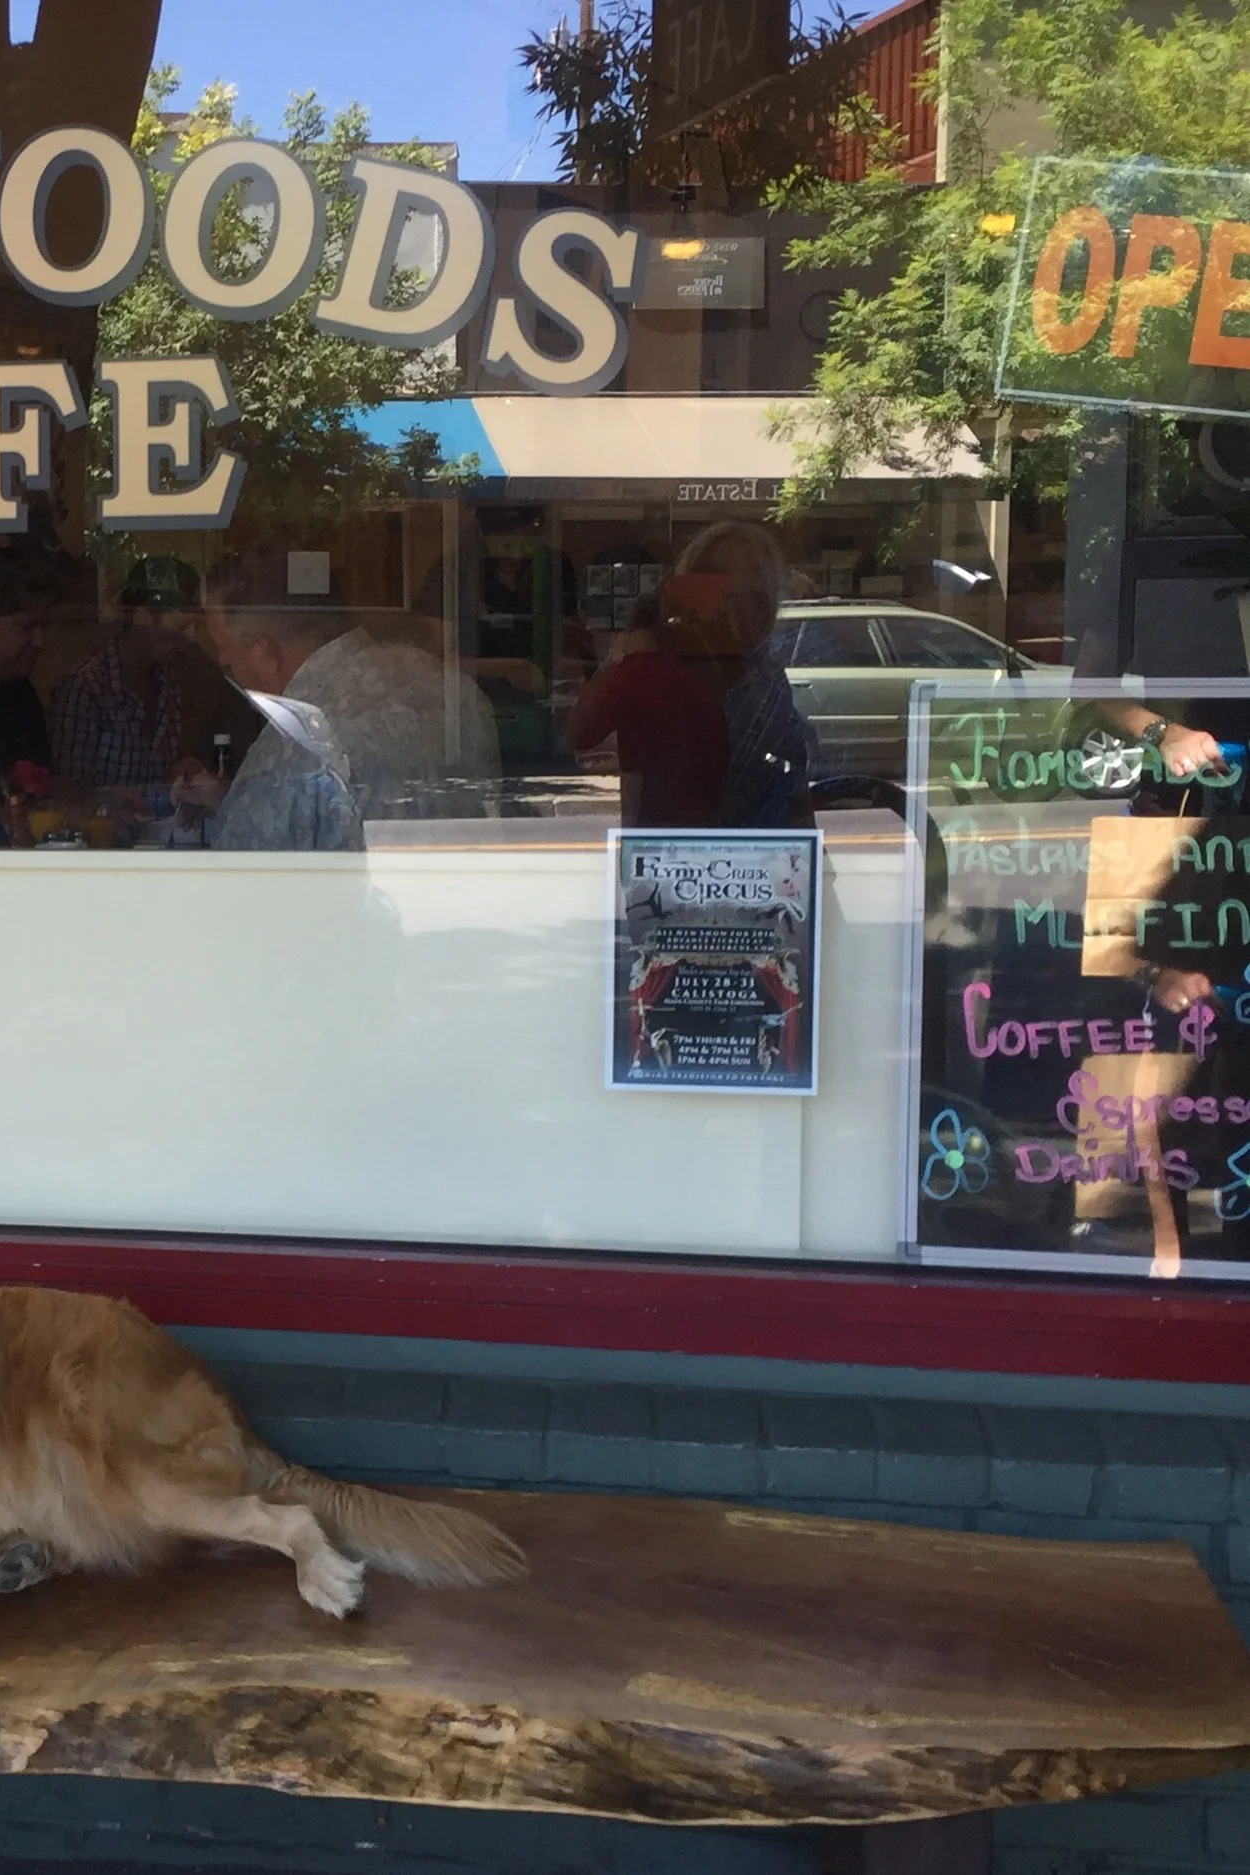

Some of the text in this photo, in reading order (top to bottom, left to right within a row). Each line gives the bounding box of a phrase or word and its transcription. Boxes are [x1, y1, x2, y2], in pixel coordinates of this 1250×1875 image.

[674, 878, 773, 904] CIRCUS
[674, 976, 709, 987] JULY
[671, 988, 758, 1000] CALISTOGA
